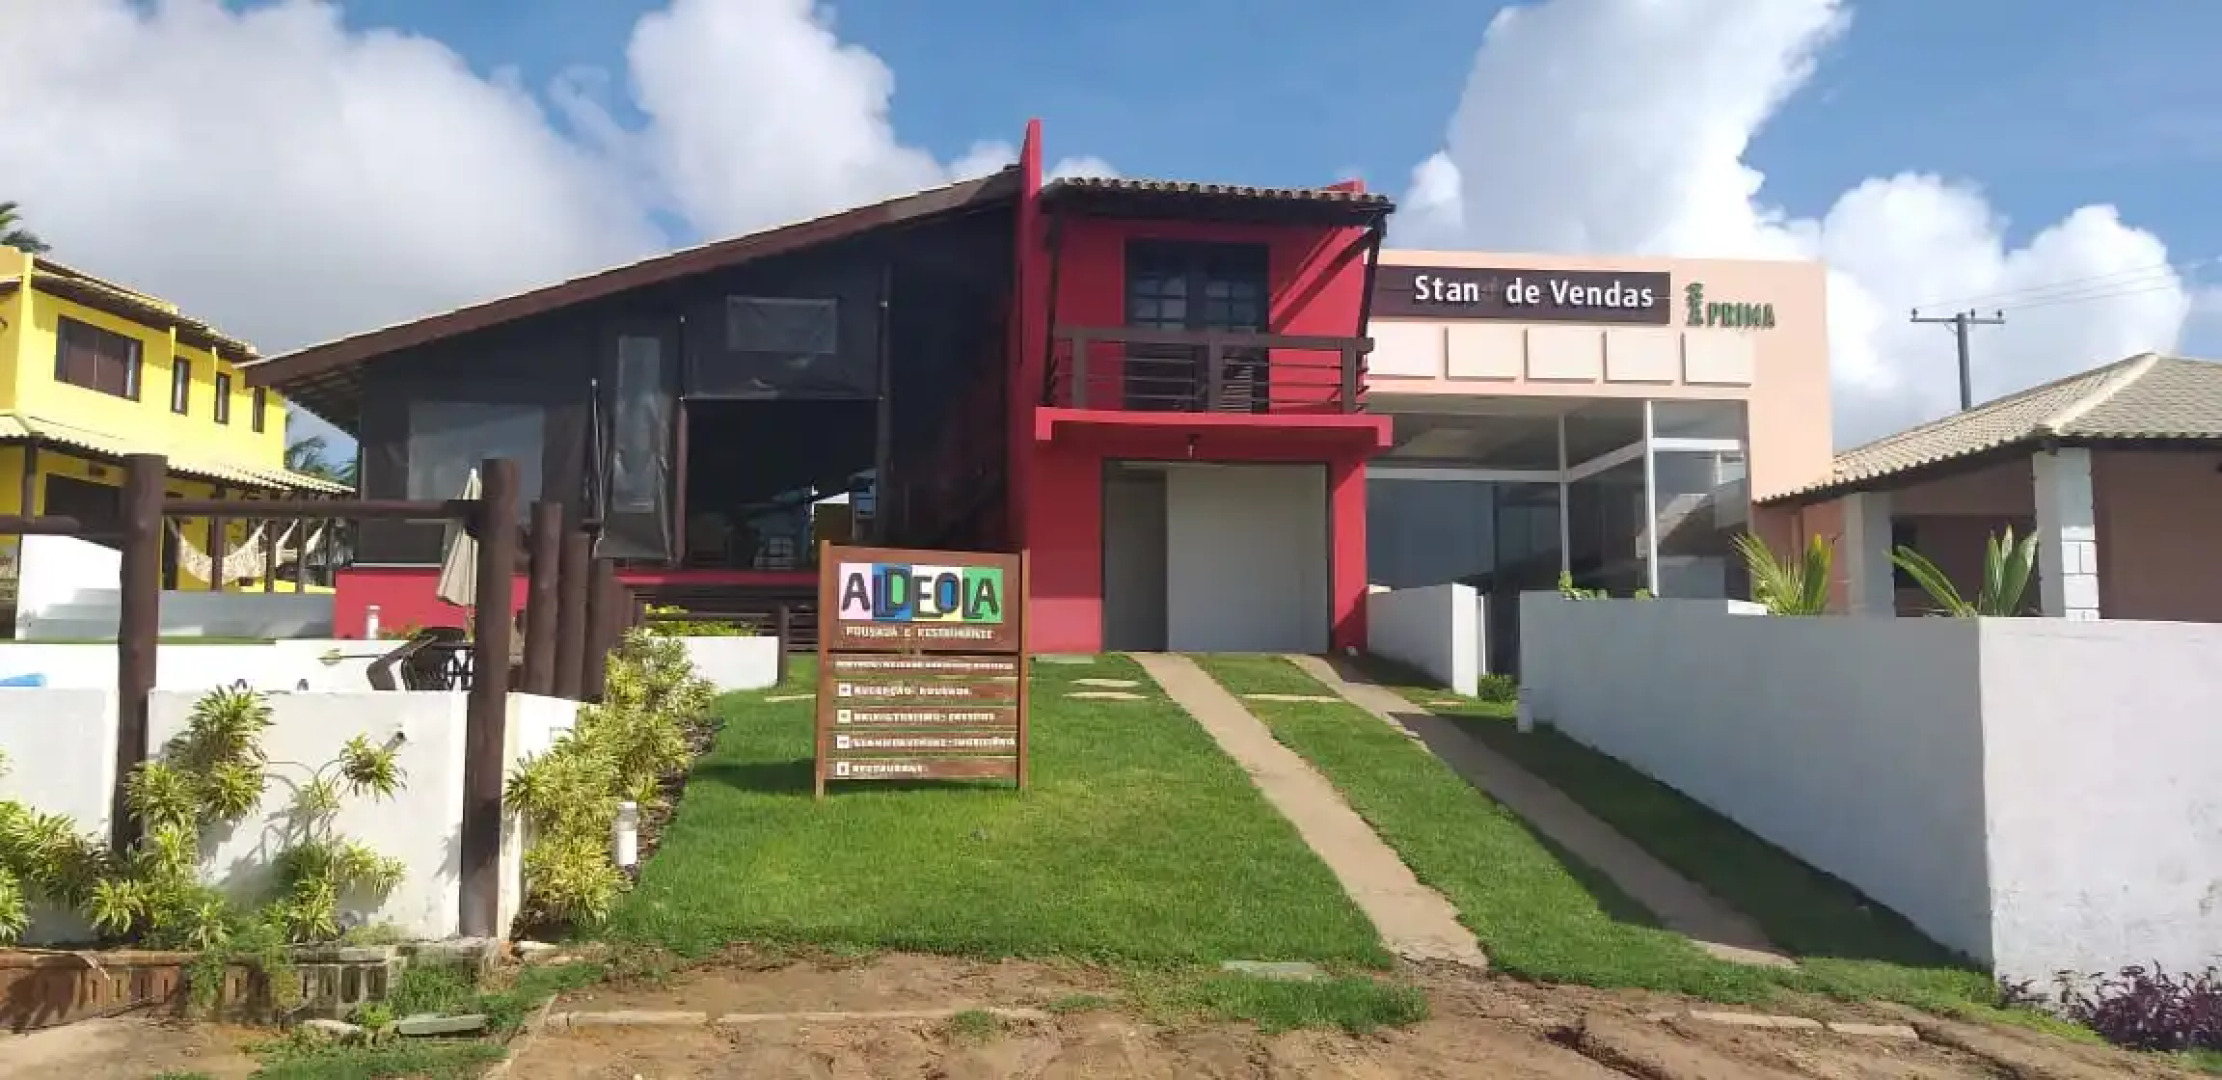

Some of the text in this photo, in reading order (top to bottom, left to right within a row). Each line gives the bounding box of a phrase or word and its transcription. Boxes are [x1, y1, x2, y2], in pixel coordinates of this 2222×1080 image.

[1415, 275, 1653, 307] Stan de Vendas
[1707, 302, 1775, 328] PRIMA
[842, 568, 999, 619] ALDEOLA
